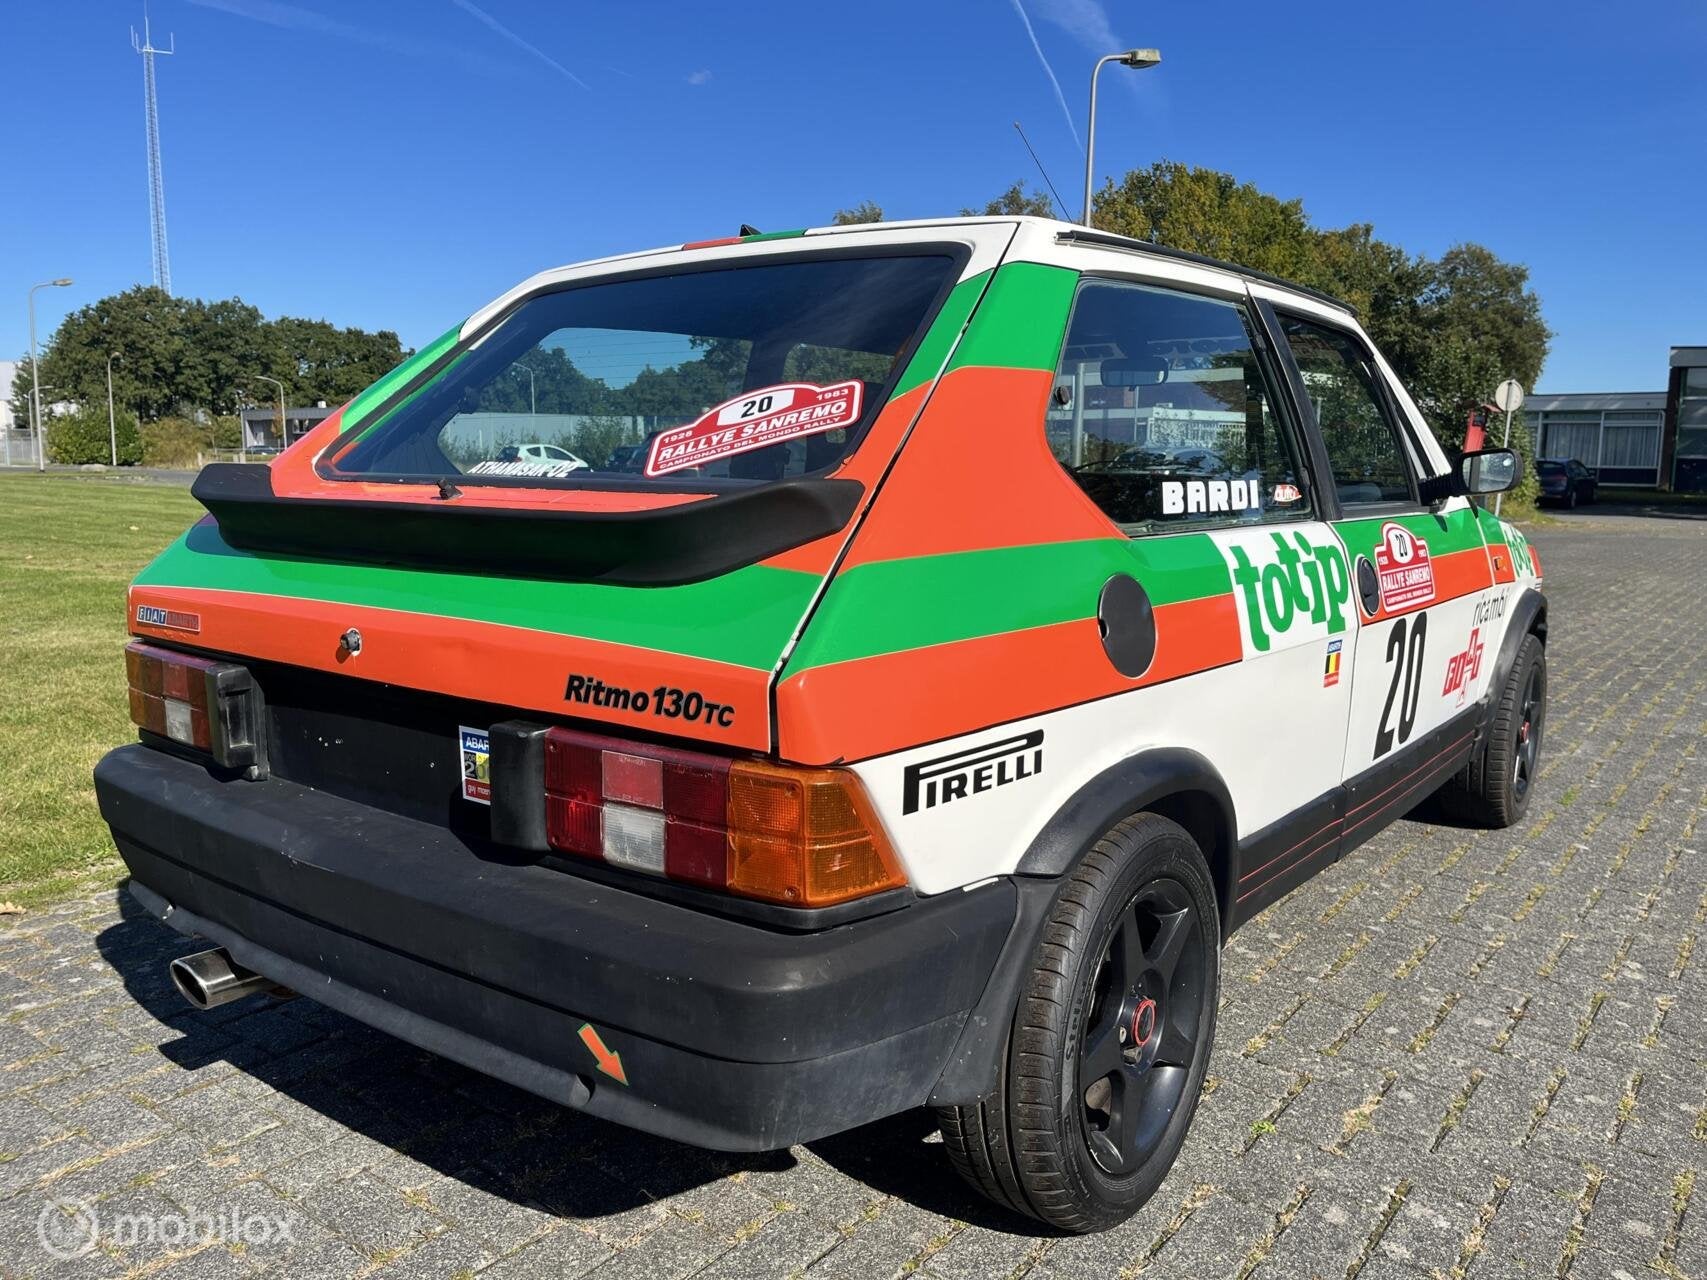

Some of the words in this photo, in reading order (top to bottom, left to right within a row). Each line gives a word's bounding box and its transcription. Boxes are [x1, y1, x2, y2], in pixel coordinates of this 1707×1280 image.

[741, 395, 773, 419] 20
[816, 388, 849, 401] 1983
[658, 429, 737, 462] RALLYE
[741, 401, 847, 438] SANREMO
[659, 445, 731, 469] CAMPIONATO
[734, 439, 754, 449] DEL
[758, 426, 800, 445] MONDO
[805, 416, 841, 429] RALLY
[663, 430, 693, 444] 1928
[1162, 479, 1259, 515] BARDI
[1395, 533, 1408, 557] 20
[1230, 531, 1349, 652] totip
[1382, 572, 1405, 591] RALLYE
[138, 606, 166, 624] FIAT
[1472, 587, 1510, 627] ricambi
[564, 674, 649, 712] Ritmo
[1373, 611, 1427, 761] 20
[903, 729, 1044, 816] PIRELLI
